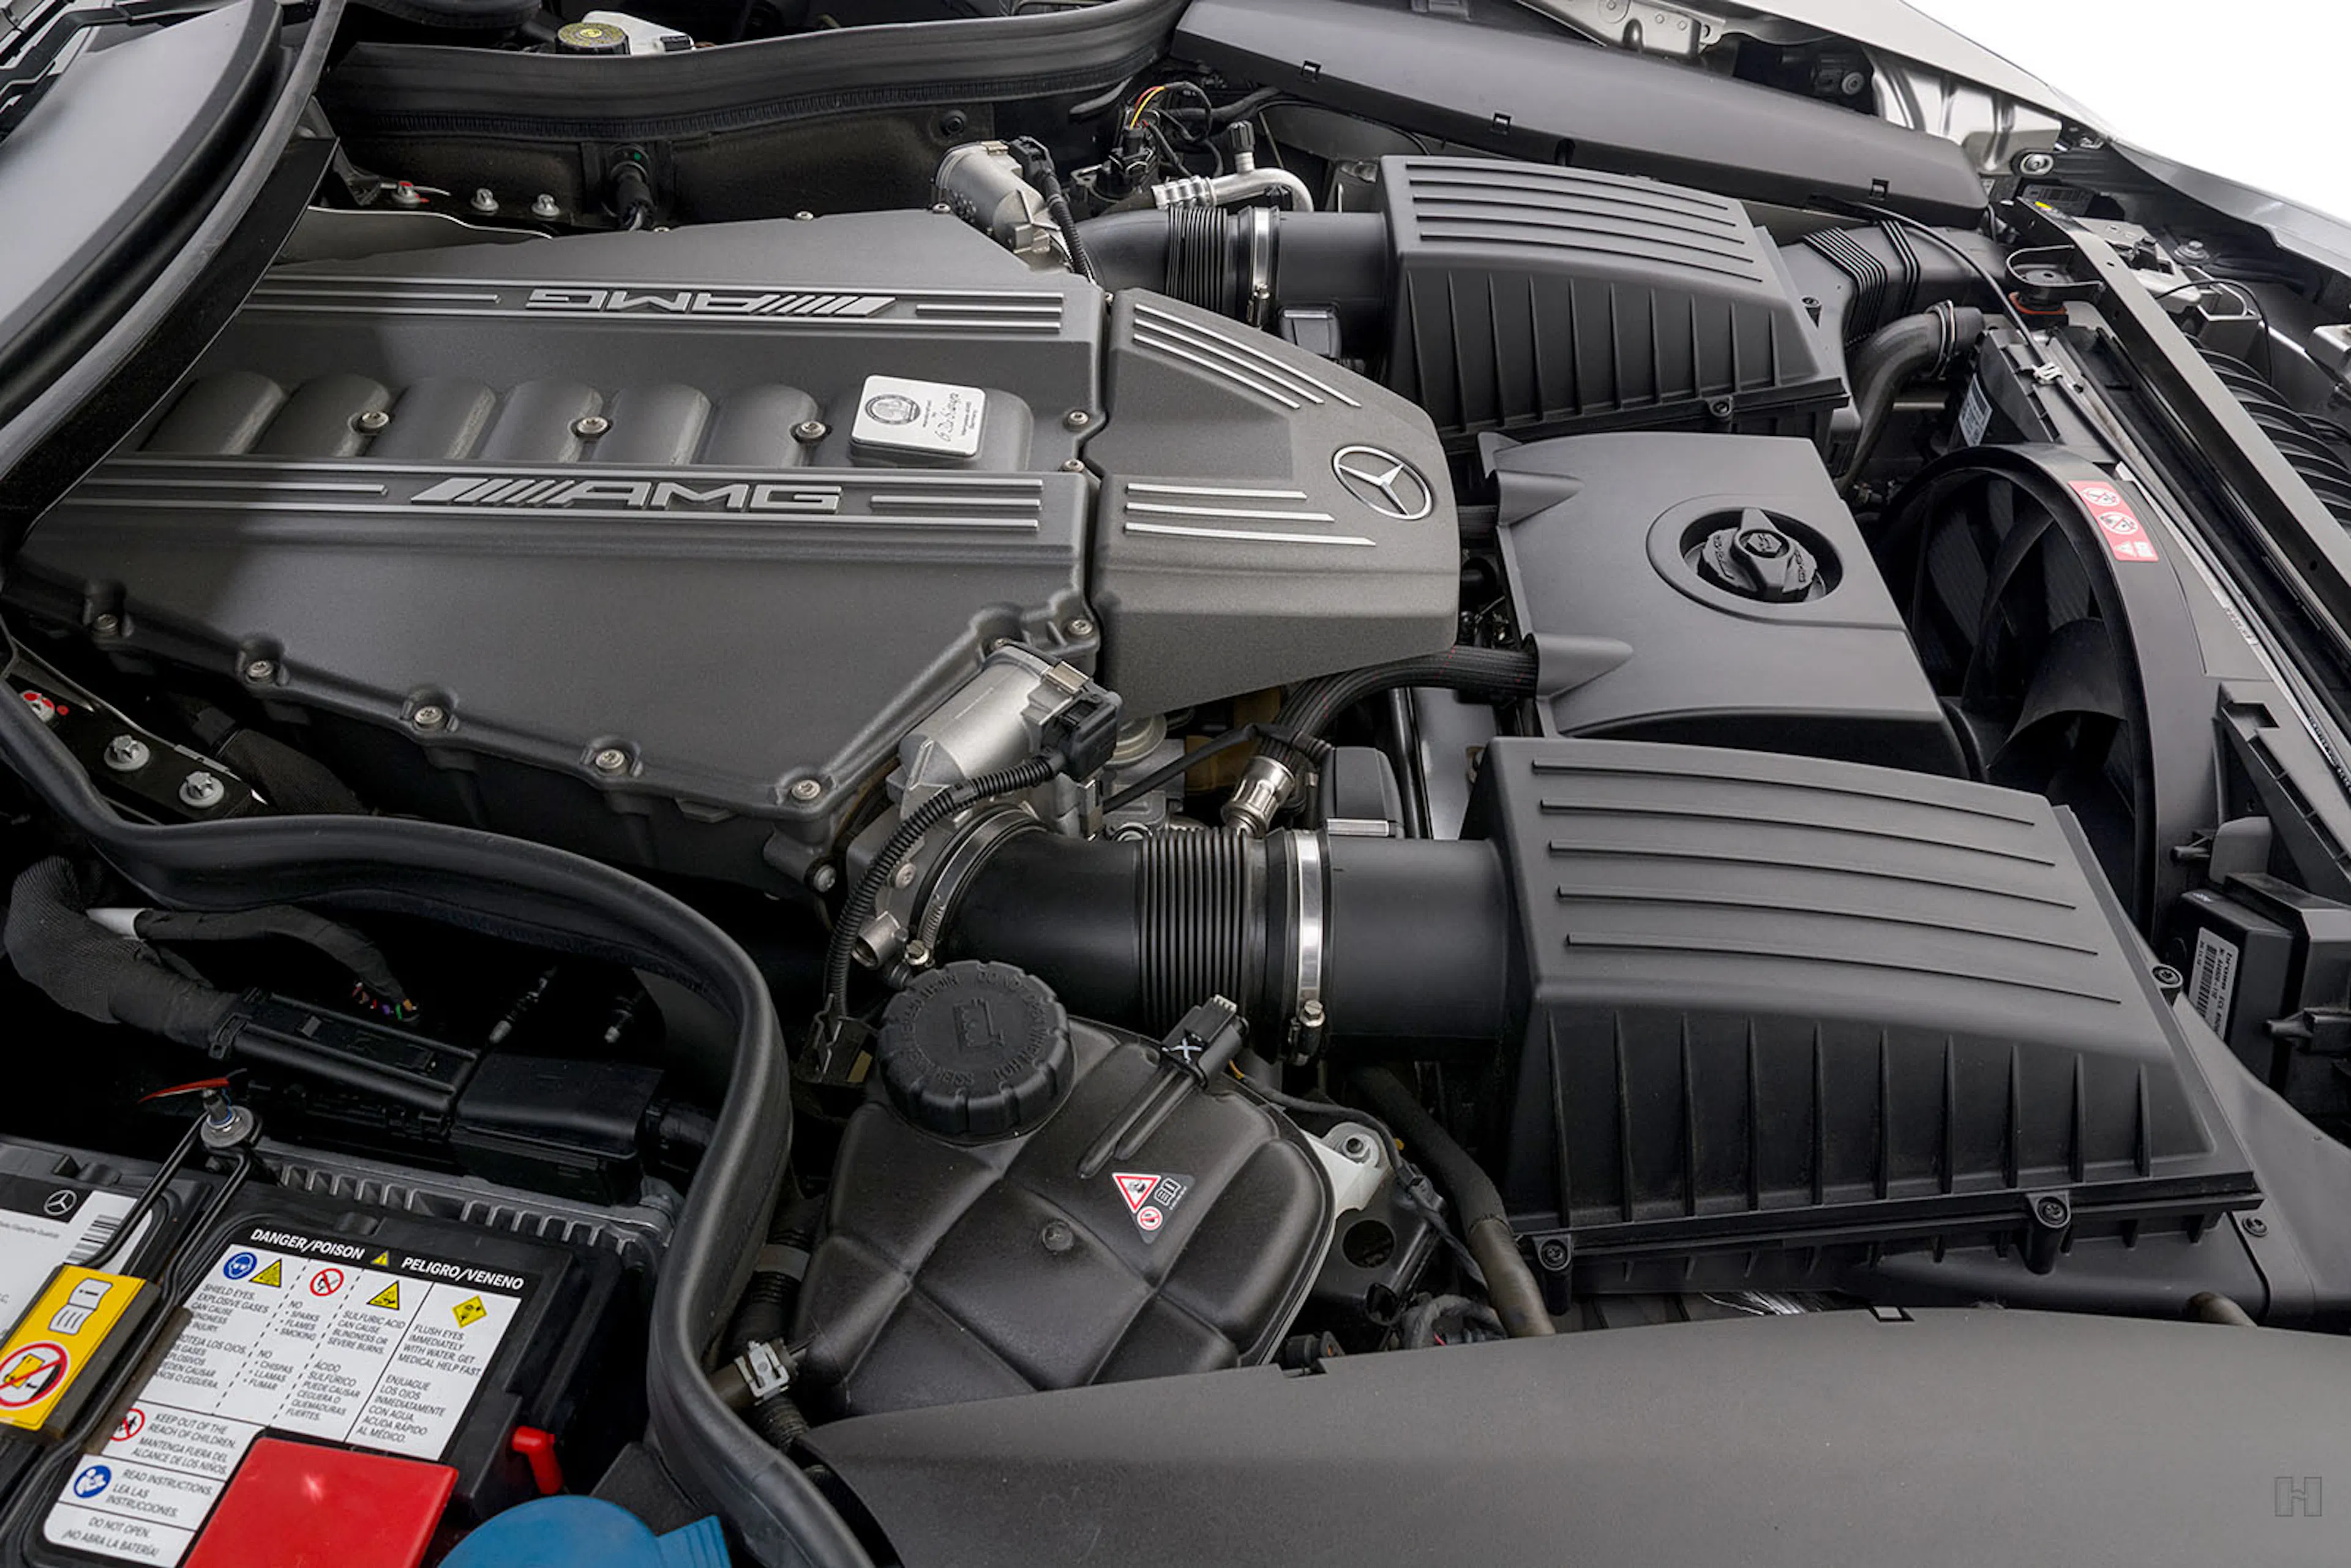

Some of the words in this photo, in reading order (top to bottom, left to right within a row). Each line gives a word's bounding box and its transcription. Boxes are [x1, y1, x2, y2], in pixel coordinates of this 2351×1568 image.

[527, 288, 781, 314] AMG
[546, 479, 842, 514] AMG
[251, 1229, 365, 1259] DANGER/POISON
[401, 1257, 524, 1289] PELIGRO/VENENO
[203, 1285, 232, 1295] SHIELD
[197, 1294, 240, 1307] EXPLOSIVE
[242, 1303, 269, 1313] GASES
[209, 1307, 233, 1315] CAUSE
[291, 1311, 320, 1321] SPARKS
[286, 1319, 316, 1330] FLAMES
[343, 1310, 384, 1323] SULFURIC
[384, 1319, 405, 1329] ACID
[280, 1329, 317, 1340] SMOKING
[356, 1322, 380, 1333] CAUSE
[413, 1324, 442, 1335] FLUSH
[328, 1337, 356, 1348] SEVERE
[332, 1329, 375, 1342] BLINDNESS
[409, 1334, 465, 1351] IMMEDIATELY
[258, 1350, 272, 1359] NO
[403, 1345, 426, 1354] WITH
[459, 1354, 475, 1364] GET
[260, 1361, 293, 1373] CHISPAS
[314, 1360, 341, 1373] ÁCIDO
[399, 1354, 433, 1367] MEDICAL
[436, 1362, 459, 1372] HELP
[186, 1366, 216, 1376] CAUSAR
[254, 1370, 286, 1382] LLAMAS
[249, 1379, 277, 1389] FUMAR
[303, 1382, 330, 1391] PUEDE
[329, 1386, 361, 1398] CAUSAR
[386, 1375, 430, 1391] ENJUAGUE
[297, 1390, 332, 1401] CEGUERA
[380, 1386, 397, 1395] LOS
[398, 1389, 422, 1400] OJOS
[291, 1400, 347, 1416] QUEMADURAS
[369, 1406, 388, 1416] CON
[375, 1396, 446, 1417] INMEDIATAMENTE
[155, 1413, 176, 1423] KEEP
[177, 1417, 197, 1427] OUT
[197, 1420, 210, 1430] OF
[212, 1424, 228, 1435] THE
[356, 1425, 367, 1435] AL
[362, 1415, 392, 1427] ACUDA
[394, 1420, 427, 1435] RÁPIDO
[149, 1425, 178, 1437] REACH
[178, 1430, 192, 1439] OF
[140, 1438, 184, 1453] MANTENGA
[184, 1447, 212, 1459] FUERA
[212, 1452, 227, 1462] DEL
[132, 1448, 168, 1463] ALCANCE
[170, 1455, 183, 1466] DE
[184, 1458, 200, 1468] LOS
[122, 1469, 148, 1481] READ
[113, 1483, 130, 1495] LEA
[132, 1488, 149, 1498] LAS
[88, 1516, 103, 1528] DO
[103, 1520, 125, 1531] NOT
[81, 1532, 106, 1545] ABRA
[107, 1539, 119, 1548] LA
